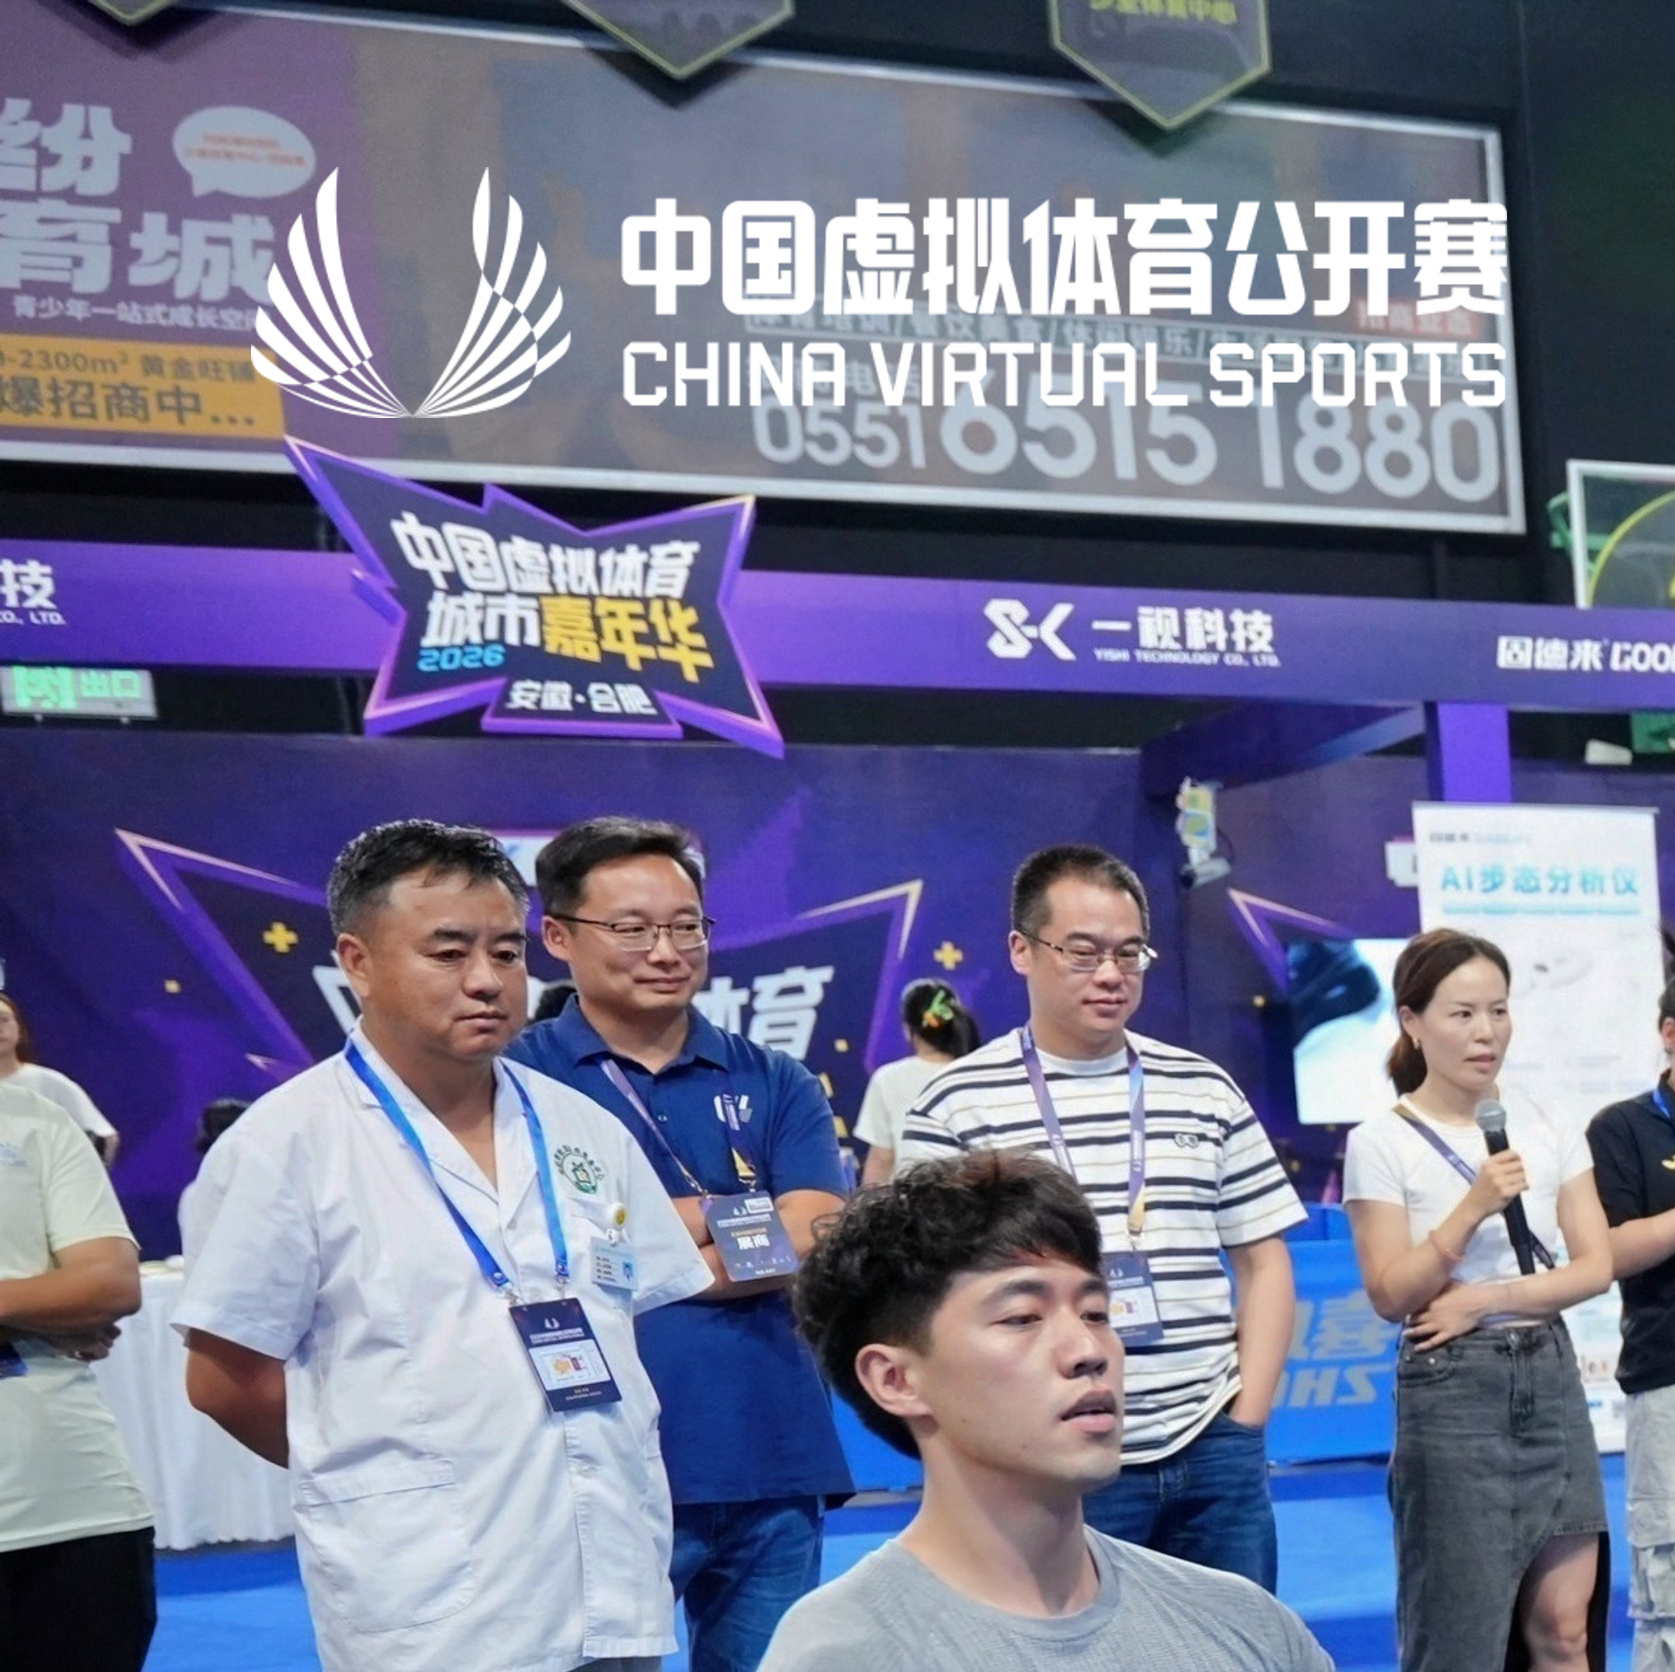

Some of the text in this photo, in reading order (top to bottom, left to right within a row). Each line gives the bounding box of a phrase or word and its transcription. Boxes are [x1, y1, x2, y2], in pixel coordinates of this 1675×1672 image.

[753, 394, 928, 471] 0551
[939, 366, 1219, 488] 6515
[1252, 384, 1501, 503] 1880
[390, 510, 700, 599] 中国虚拟体育
[0, 558, 58, 610] 技
[420, 590, 715, 684] 城市嘉年华
[1091, 605, 1275, 653] 一视科技
[416, 644, 506, 673] 2026
[1440, 860, 1640, 896] AI步态分析仪
